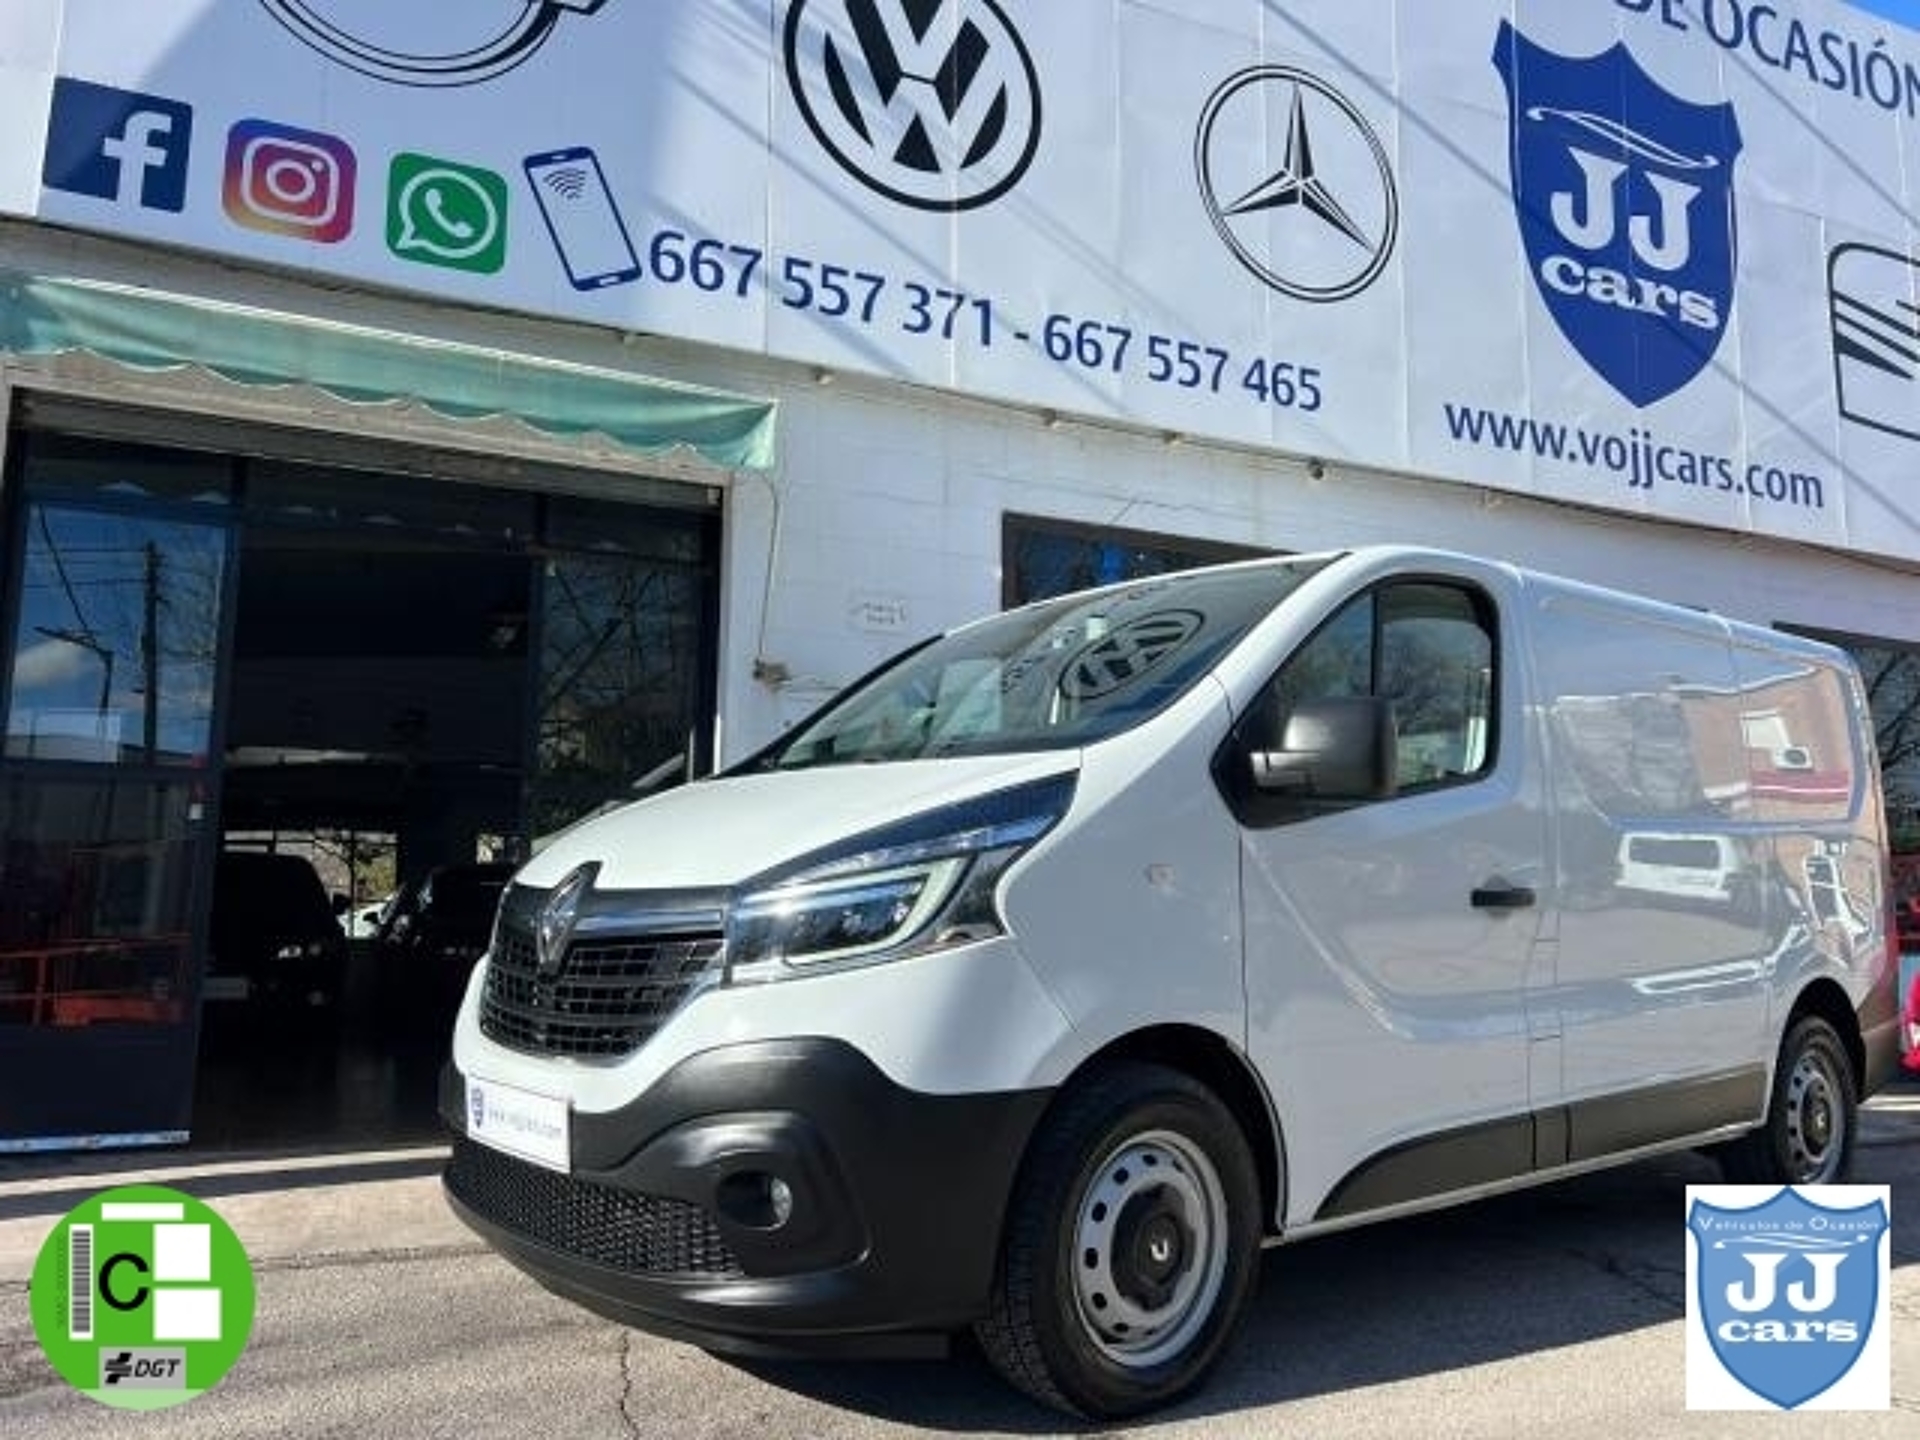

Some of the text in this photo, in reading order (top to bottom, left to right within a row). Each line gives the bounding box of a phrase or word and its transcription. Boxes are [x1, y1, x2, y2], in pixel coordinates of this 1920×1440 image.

[1614, 0, 1688, 31] E
[1550, 146, 1702, 271] JJ
[650, 231, 763, 296] 667
[782, 257, 886, 322] 557
[902, 282, 992, 347] 371
[1043, 314, 1132, 372] 667
[1148, 335, 1229, 393] 557
[1243, 358, 1321, 411] 465
[1541, 255, 1720, 330] cars
[1444, 403, 1824, 508] www.vojjcars.com
